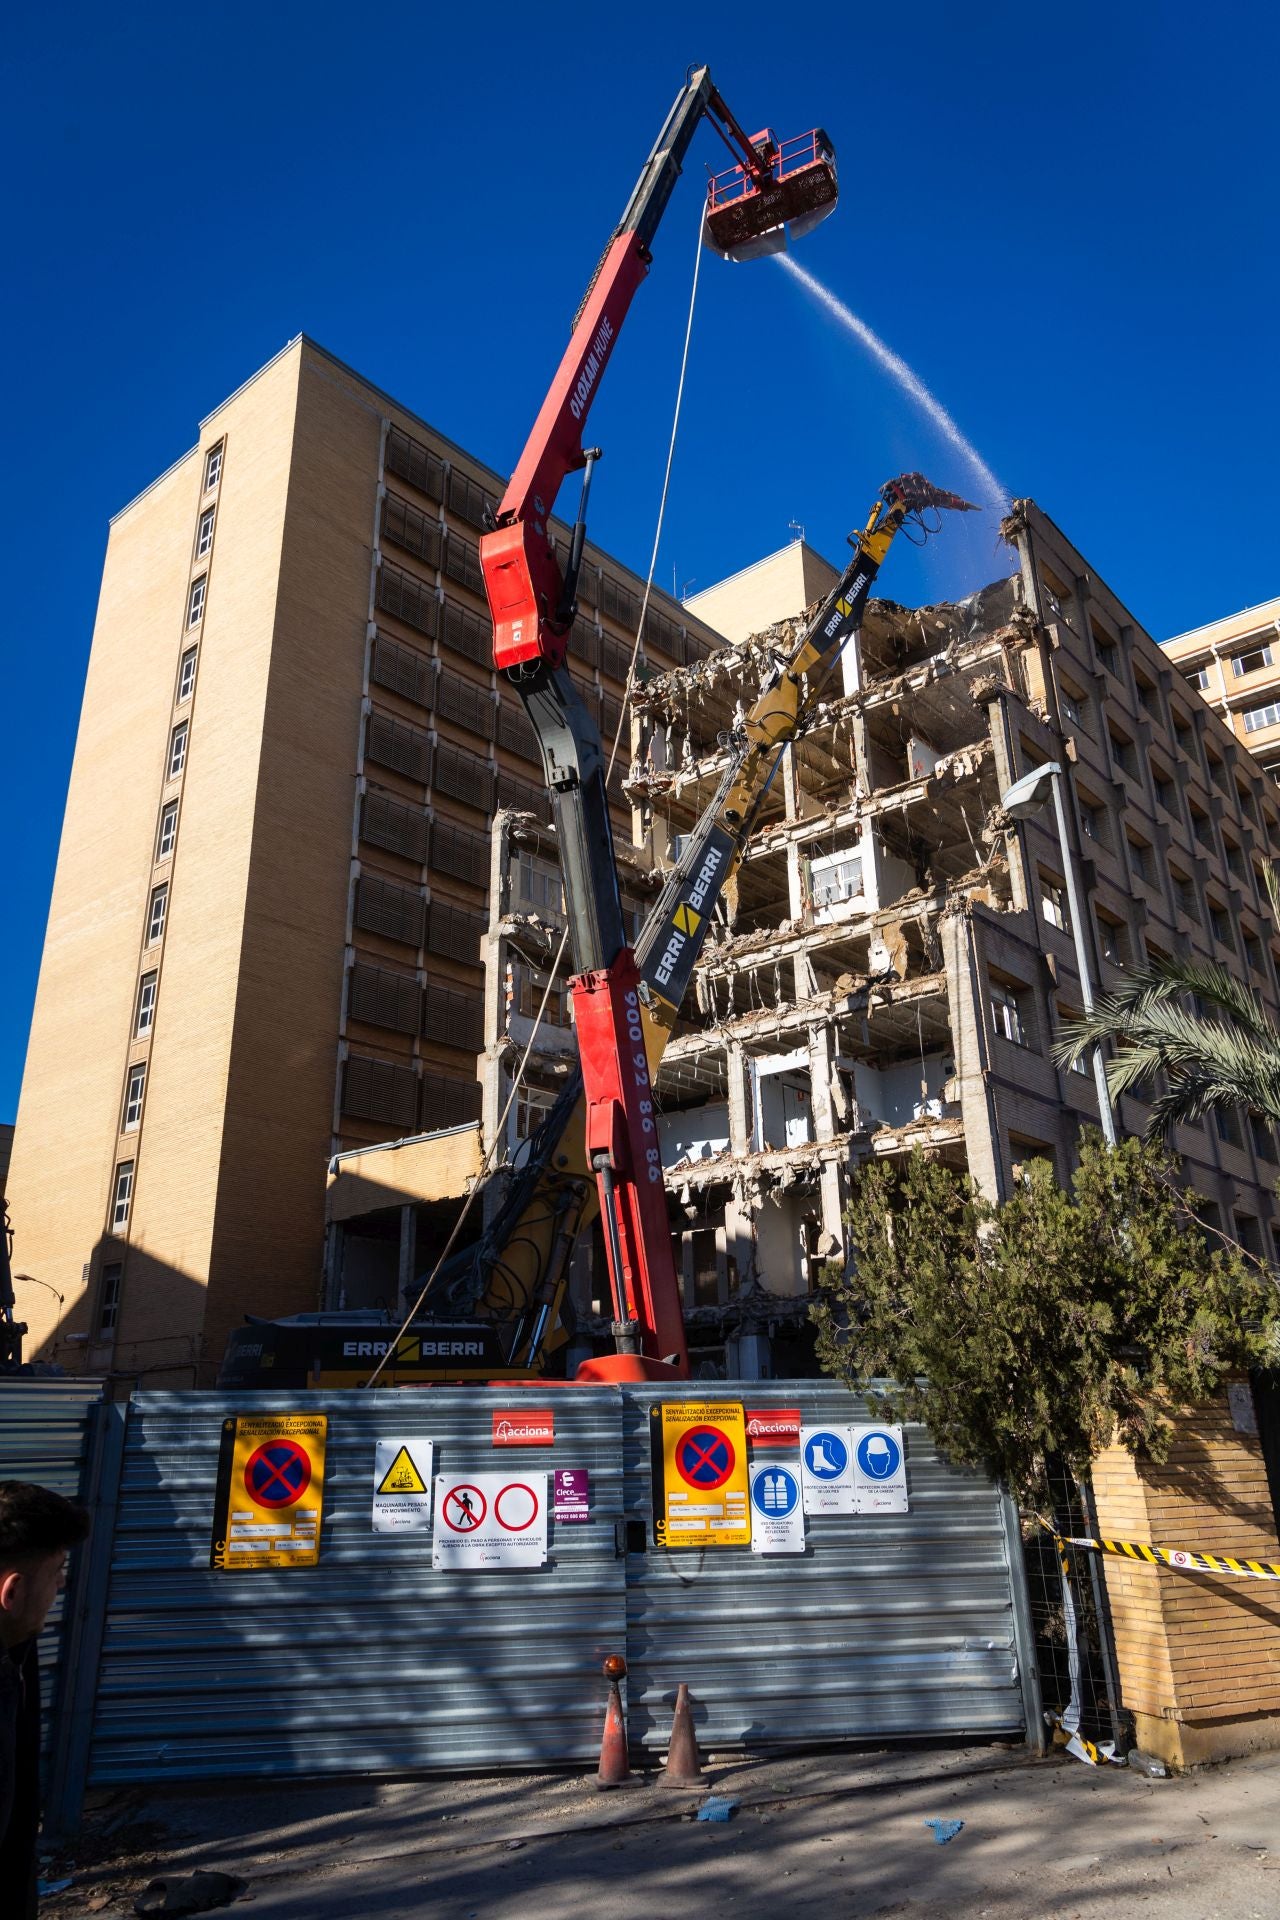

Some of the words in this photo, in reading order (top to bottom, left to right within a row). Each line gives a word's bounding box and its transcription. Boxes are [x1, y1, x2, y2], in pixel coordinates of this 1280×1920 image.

[573, 352, 600, 410] LOXAM
[593, 315, 614, 361] HUNE
[824, 611, 843, 637] ERRI
[844, 572, 867, 605] BERRI
[654, 930, 686, 986] ERRI
[688, 846, 723, 911] BERRI
[624, 991, 642, 1042] 900
[633, 1053, 648, 1086] 92
[639, 1100, 655, 1133] 86
[646, 1148, 662, 1183] 86
[422, 1341, 484, 1356] BERRI
[507, 1426, 549, 1437] acciona
[758, 1423, 799, 1433] acciona
[656, 1519, 666, 1546] VLC
[213, 1540, 226, 1569] VLC
